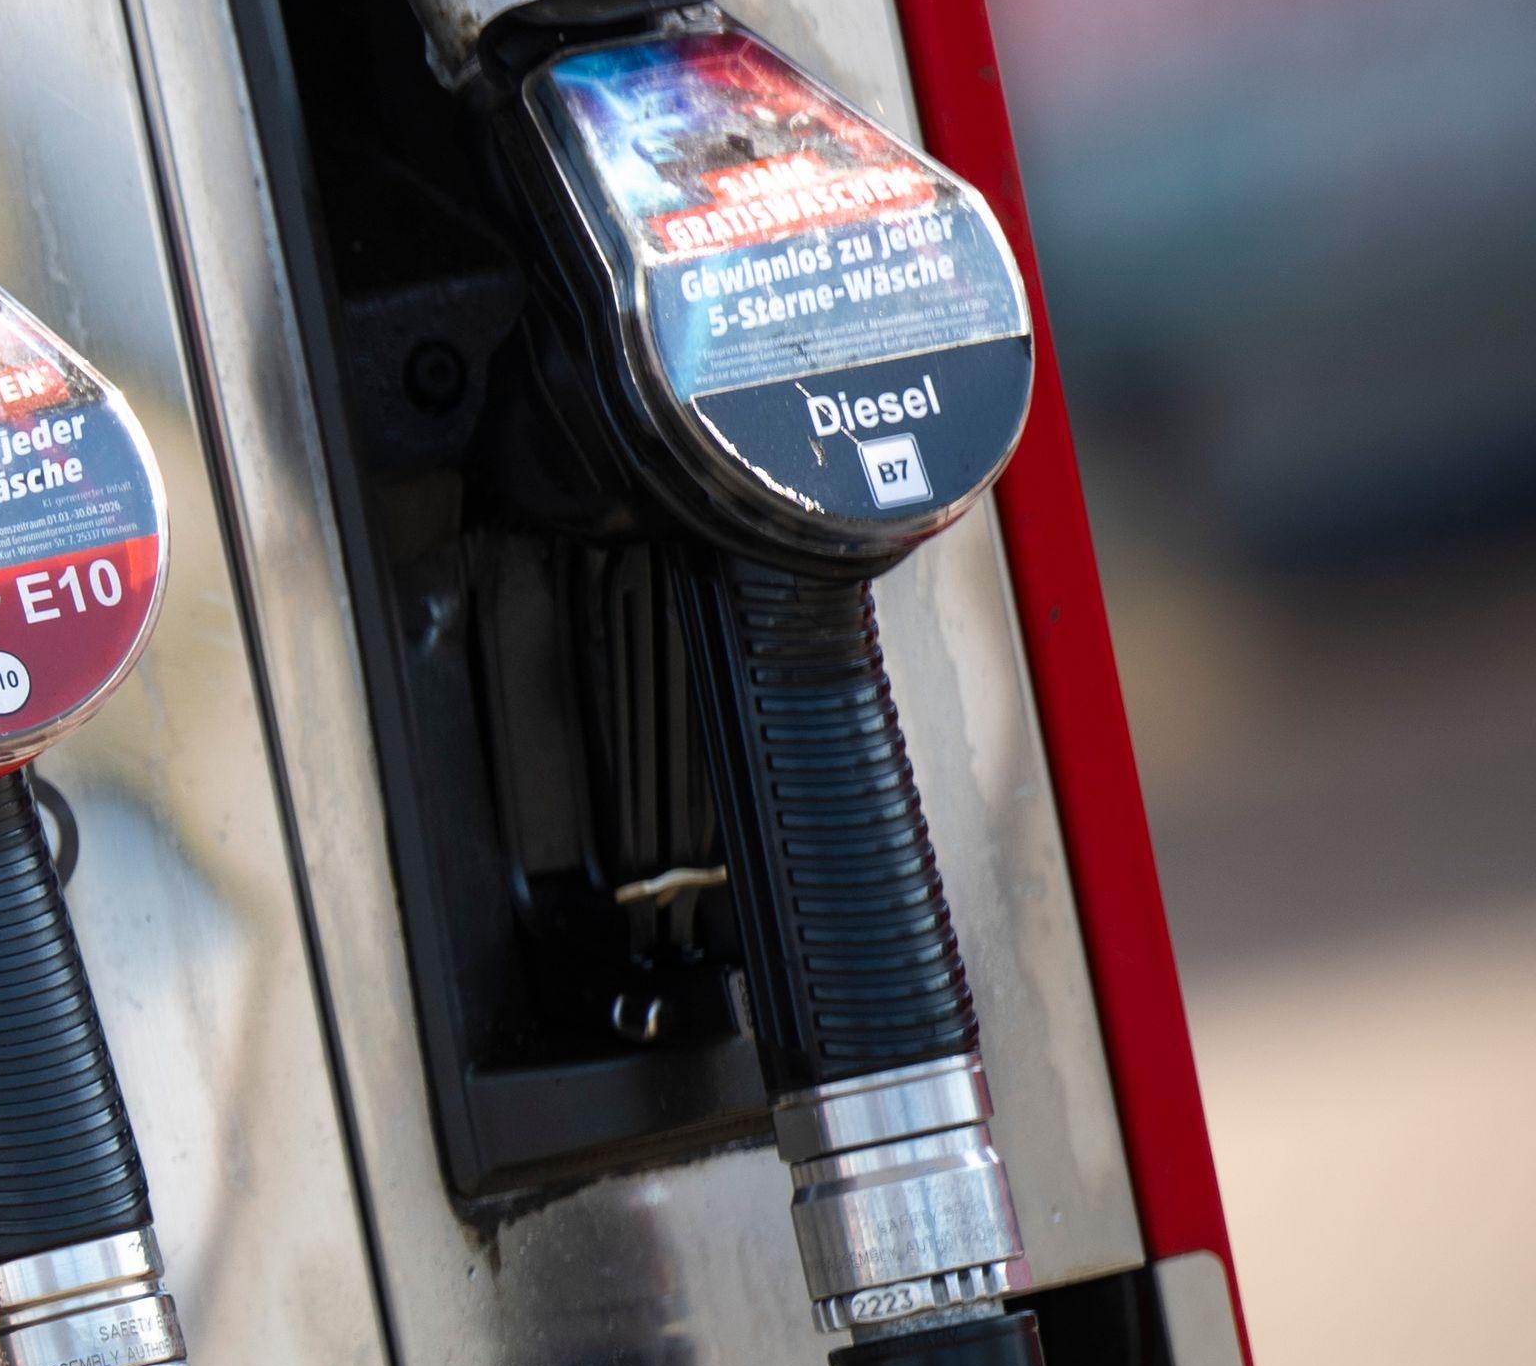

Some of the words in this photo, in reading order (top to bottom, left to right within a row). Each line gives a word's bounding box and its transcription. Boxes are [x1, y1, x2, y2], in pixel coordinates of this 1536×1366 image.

[680, 244, 832, 303] Gewinnlos
[837, 234, 873, 265] zu
[879, 213, 954, 260] jeder
[708, 253, 955, 338] 5-Sterne-Wäsche
[807, 374, 941, 437] Diesel
[0, 413, 85, 465] jeder
[878, 459, 910, 484] B7
[12, 521, 94, 546] Gewinninformationen
[95, 515, 116, 528] unter
[16, 558, 123, 624] E10
[99, 1316, 152, 1342] SAFETY
[854, 1288, 913, 1320] 2223
